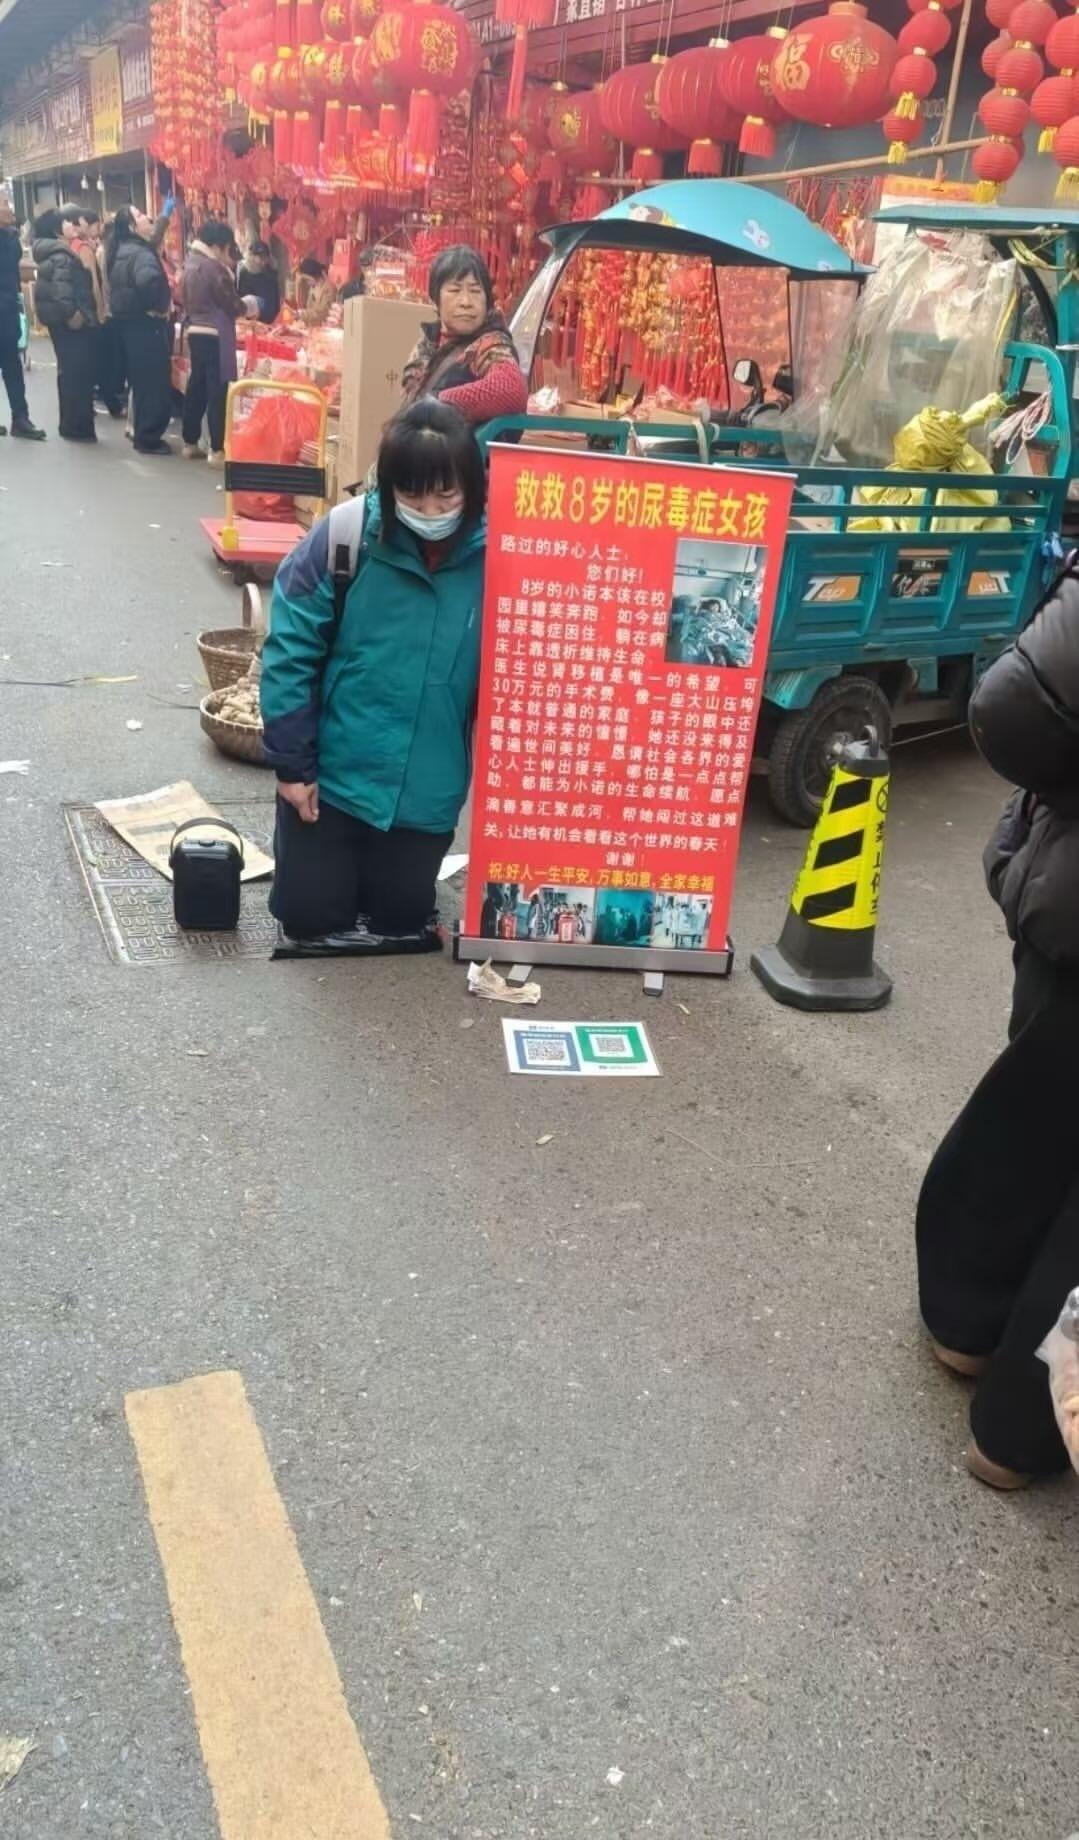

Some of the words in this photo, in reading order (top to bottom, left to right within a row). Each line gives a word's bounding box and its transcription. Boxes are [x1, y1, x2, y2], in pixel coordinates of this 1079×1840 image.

[515, 469, 770, 538] 救救8岁的尿毒症女孩
